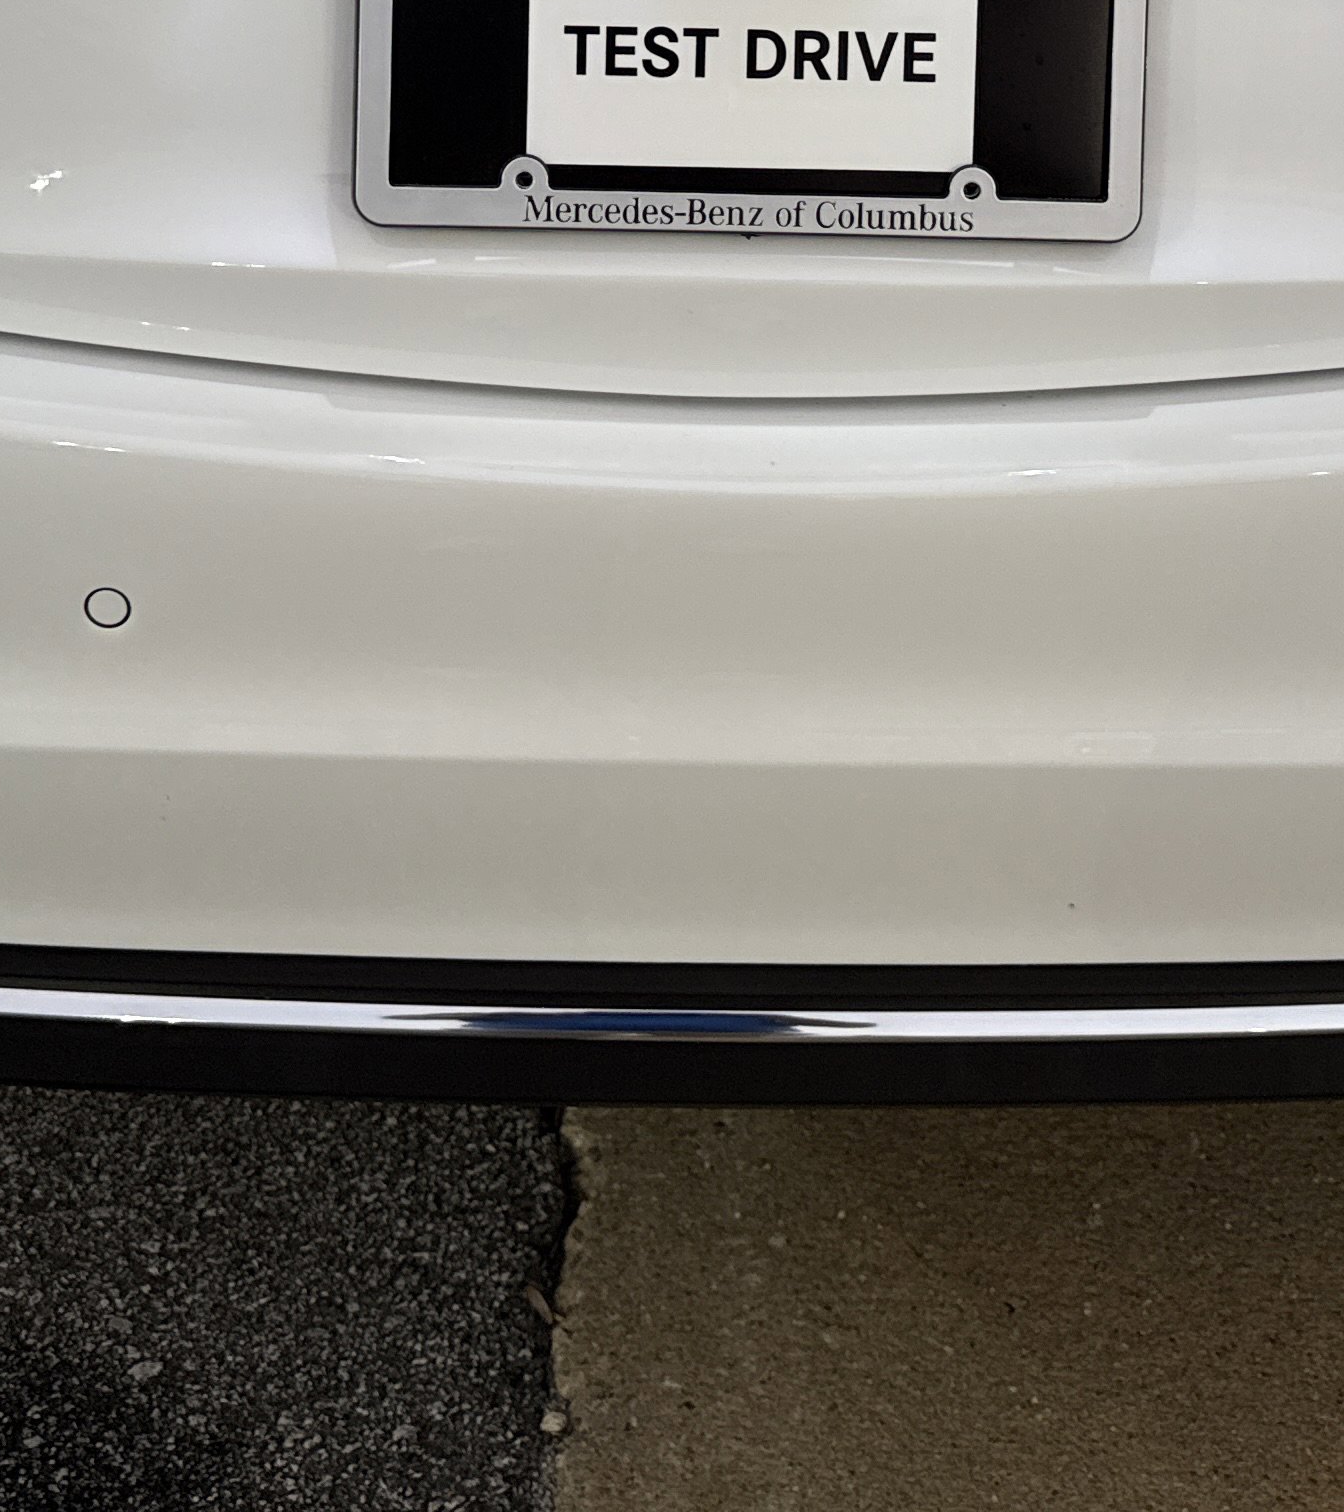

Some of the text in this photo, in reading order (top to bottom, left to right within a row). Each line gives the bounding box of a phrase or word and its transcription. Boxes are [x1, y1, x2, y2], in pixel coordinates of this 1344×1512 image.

[563, 25, 937, 83] TEST DRIVE
[522, 194, 975, 233] Mercedes-Benz of Columbus
